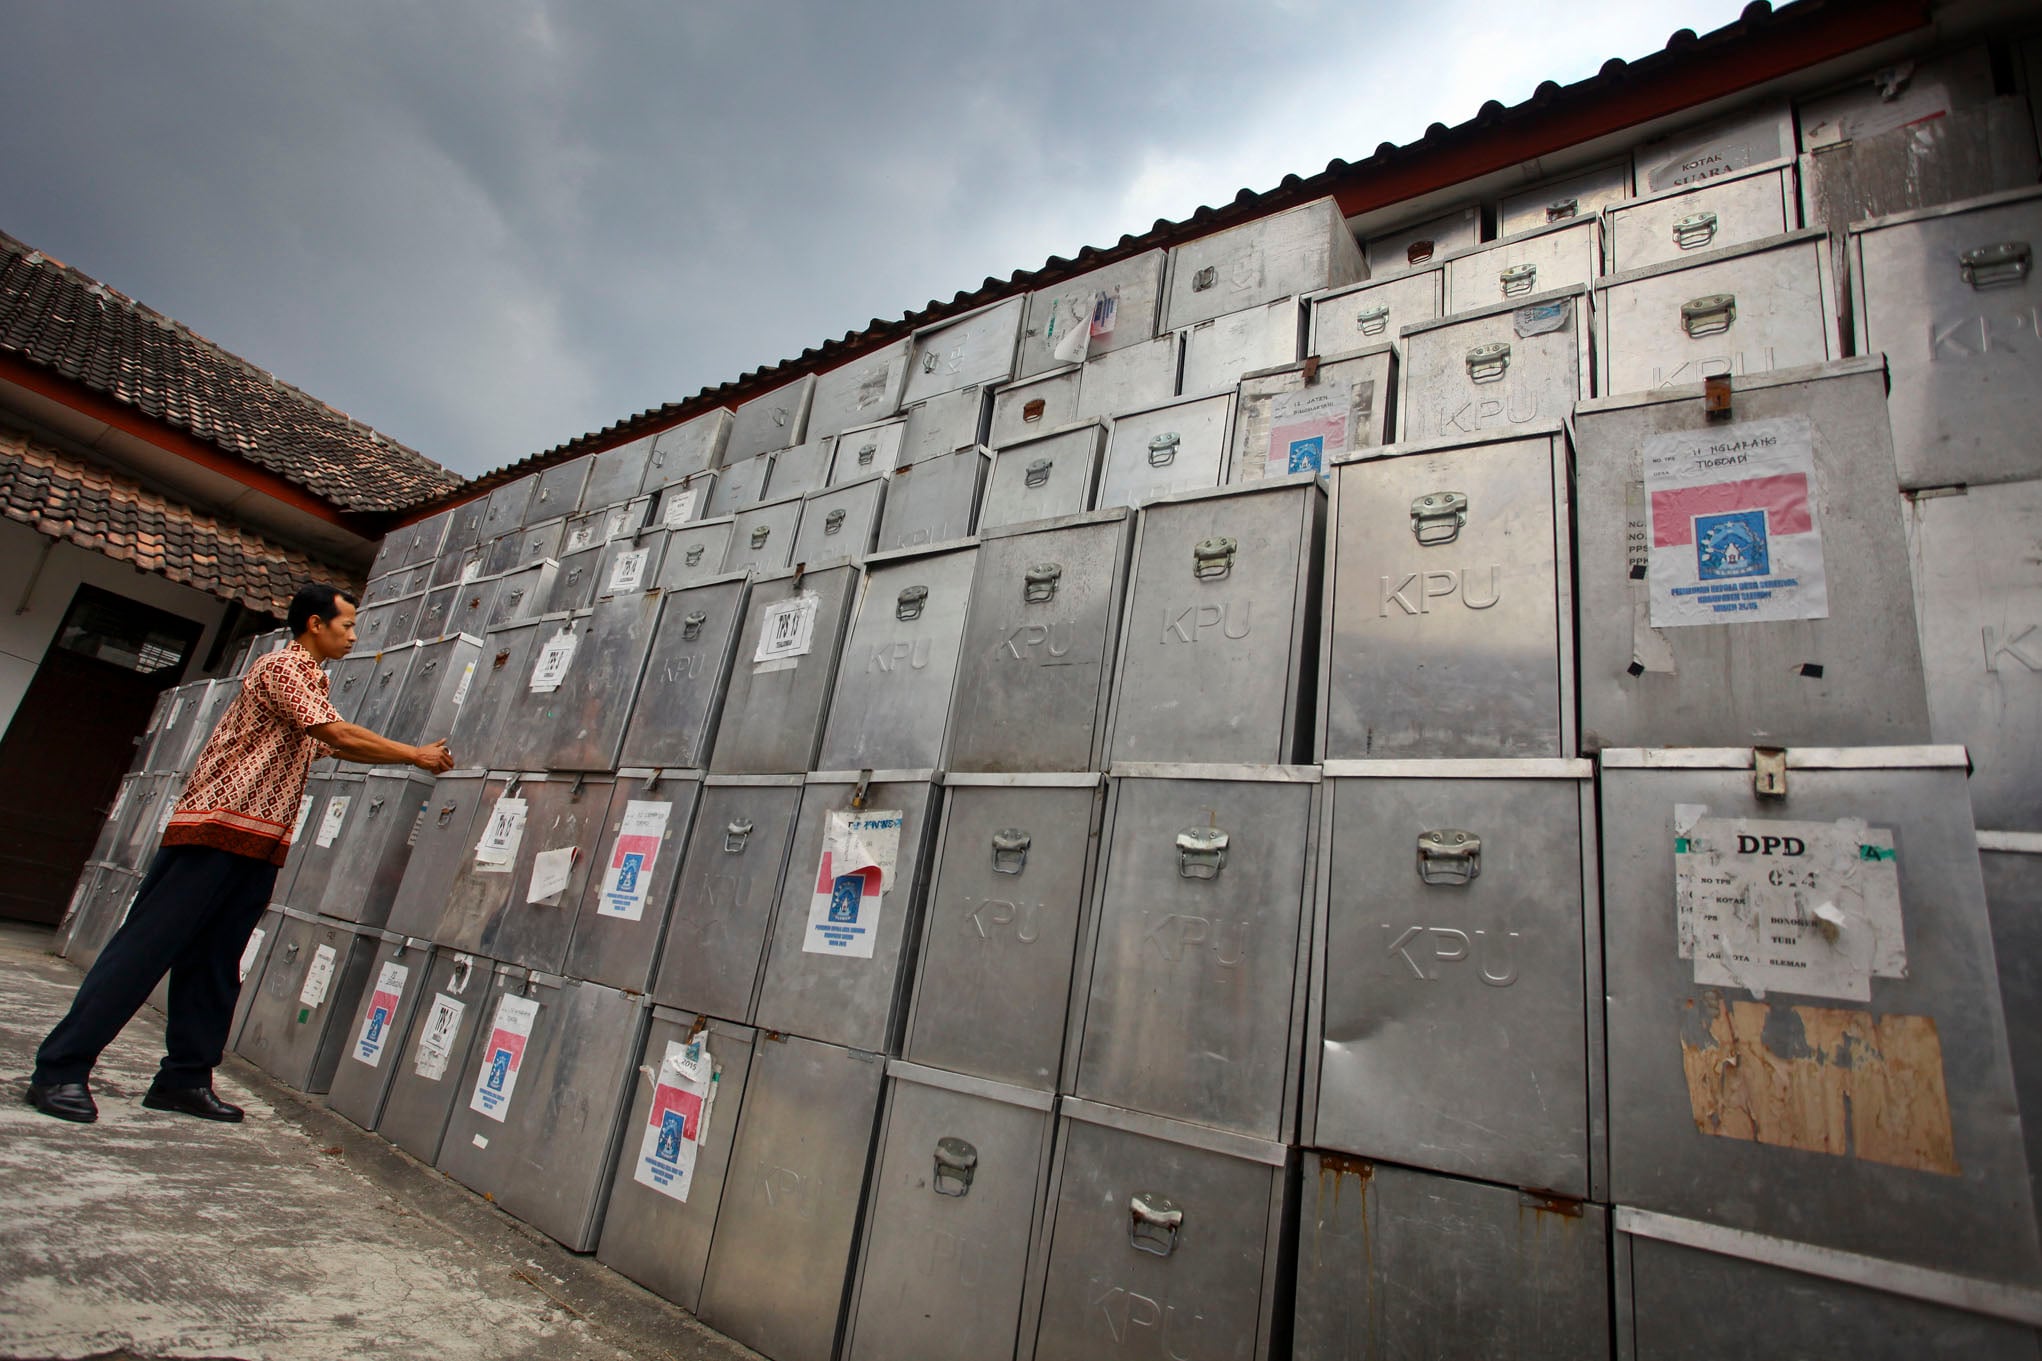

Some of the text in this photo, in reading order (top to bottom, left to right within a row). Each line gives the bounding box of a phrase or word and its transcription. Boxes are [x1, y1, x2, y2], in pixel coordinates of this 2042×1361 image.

[1682, 153, 1722, 172] KOTAK
[1440, 390, 1538, 437] KPU
[1378, 563, 1501, 618] KPU
[776, 612, 791, 640] TPS
[996, 619, 1076, 662] KPU
[1159, 600, 1251, 645] KPU
[865, 637, 933, 674] KPU
[1737, 835, 1806, 857] DPD
[965, 896, 1047, 945] KPU
[1716, 896, 1746, 905] KOTAK
[1381, 922, 1520, 986] KPU
